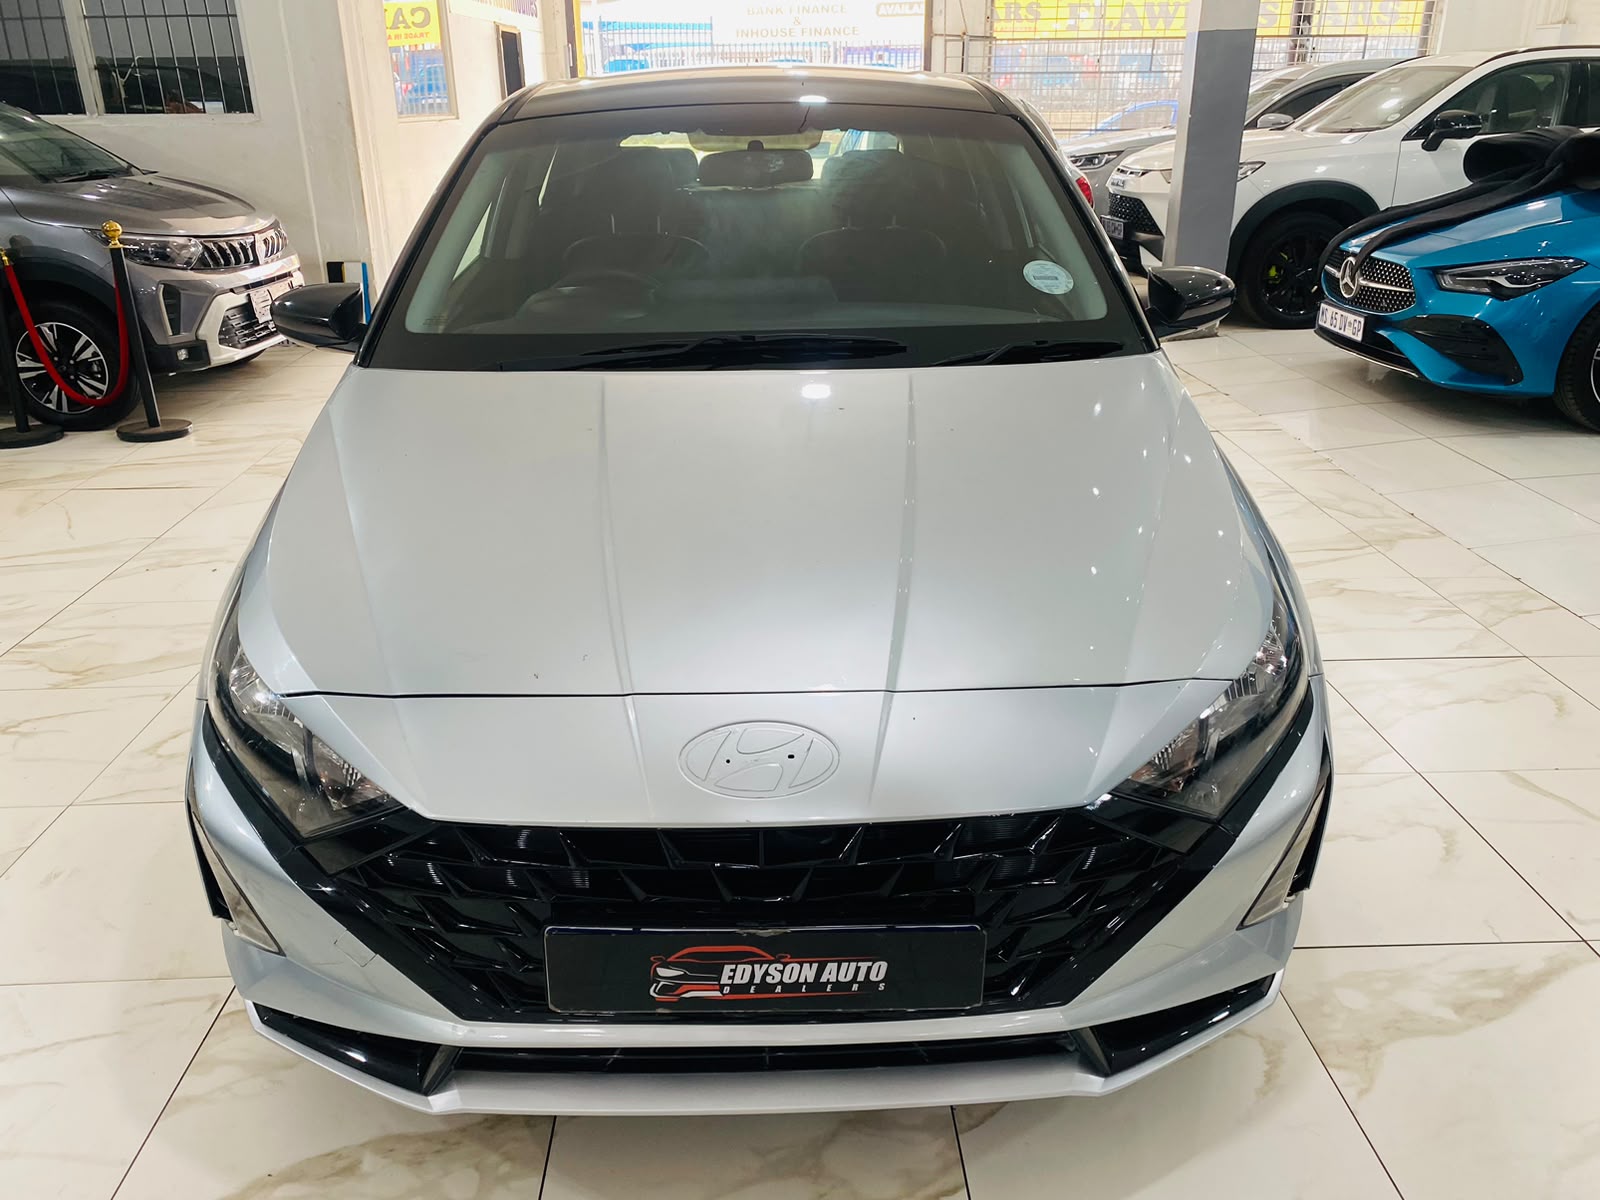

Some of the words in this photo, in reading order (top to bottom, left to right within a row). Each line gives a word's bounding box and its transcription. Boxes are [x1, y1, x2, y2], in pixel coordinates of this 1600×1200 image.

[880, 3, 924, 13] AVAILA
[736, 28, 796, 39] INHOUSE
[801, 26, 860, 37] FINANCE
[720, 962, 820, 984] EDYSON
[820, 961, 888, 983] AUTO
[723, 982, 886, 994] DEALERS
